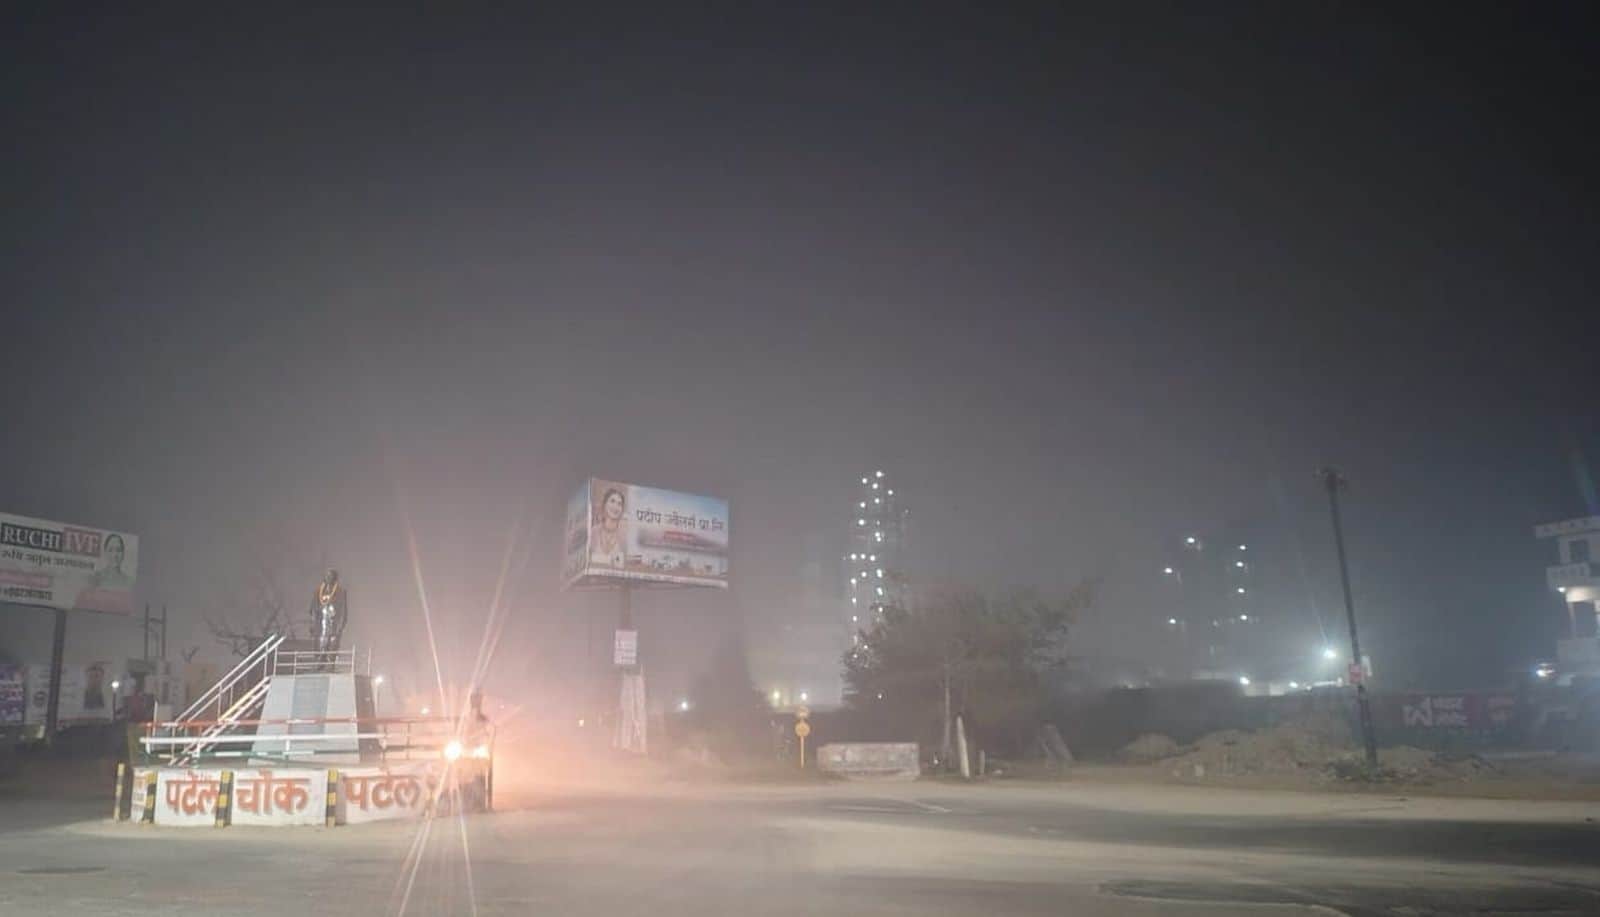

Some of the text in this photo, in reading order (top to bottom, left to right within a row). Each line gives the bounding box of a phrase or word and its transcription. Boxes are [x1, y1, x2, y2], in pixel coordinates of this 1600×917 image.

[3, 525, 101, 553] RUCHI IVF
[165, 769, 220, 814] पटेल
